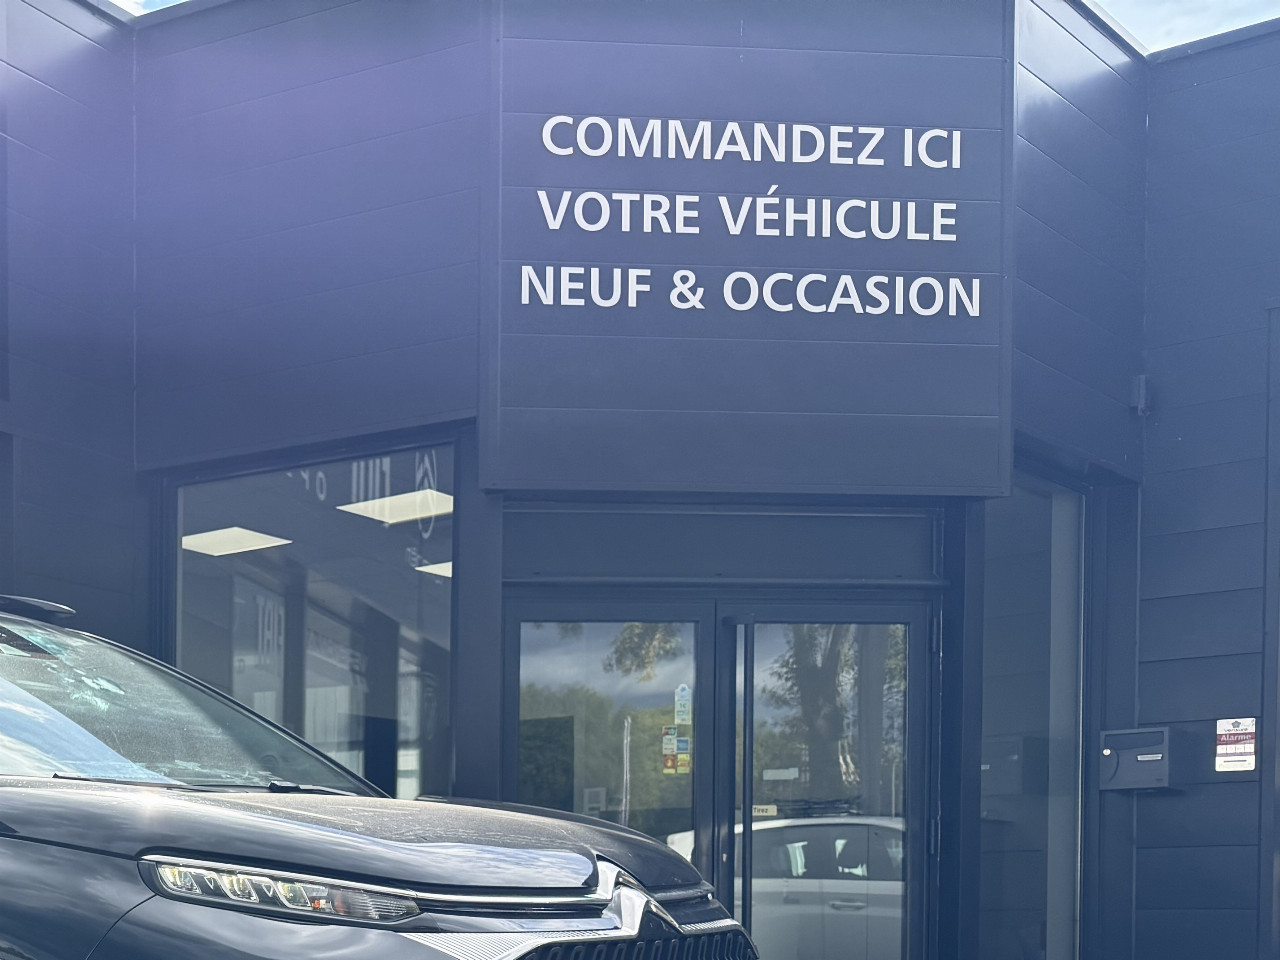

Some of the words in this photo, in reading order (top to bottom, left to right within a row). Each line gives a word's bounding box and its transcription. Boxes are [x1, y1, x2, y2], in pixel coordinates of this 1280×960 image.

[541, 115, 885, 167] COMMANDEZ
[903, 128, 962, 169] ICI
[536, 189, 701, 235] VOTRE
[718, 184, 958, 242] VÉHICULE
[520, 265, 652, 308] NEUF
[668, 269, 706, 310] &
[722, 271, 981, 317] OCCASION
[1220, 734, 1253, 742] Alarme
